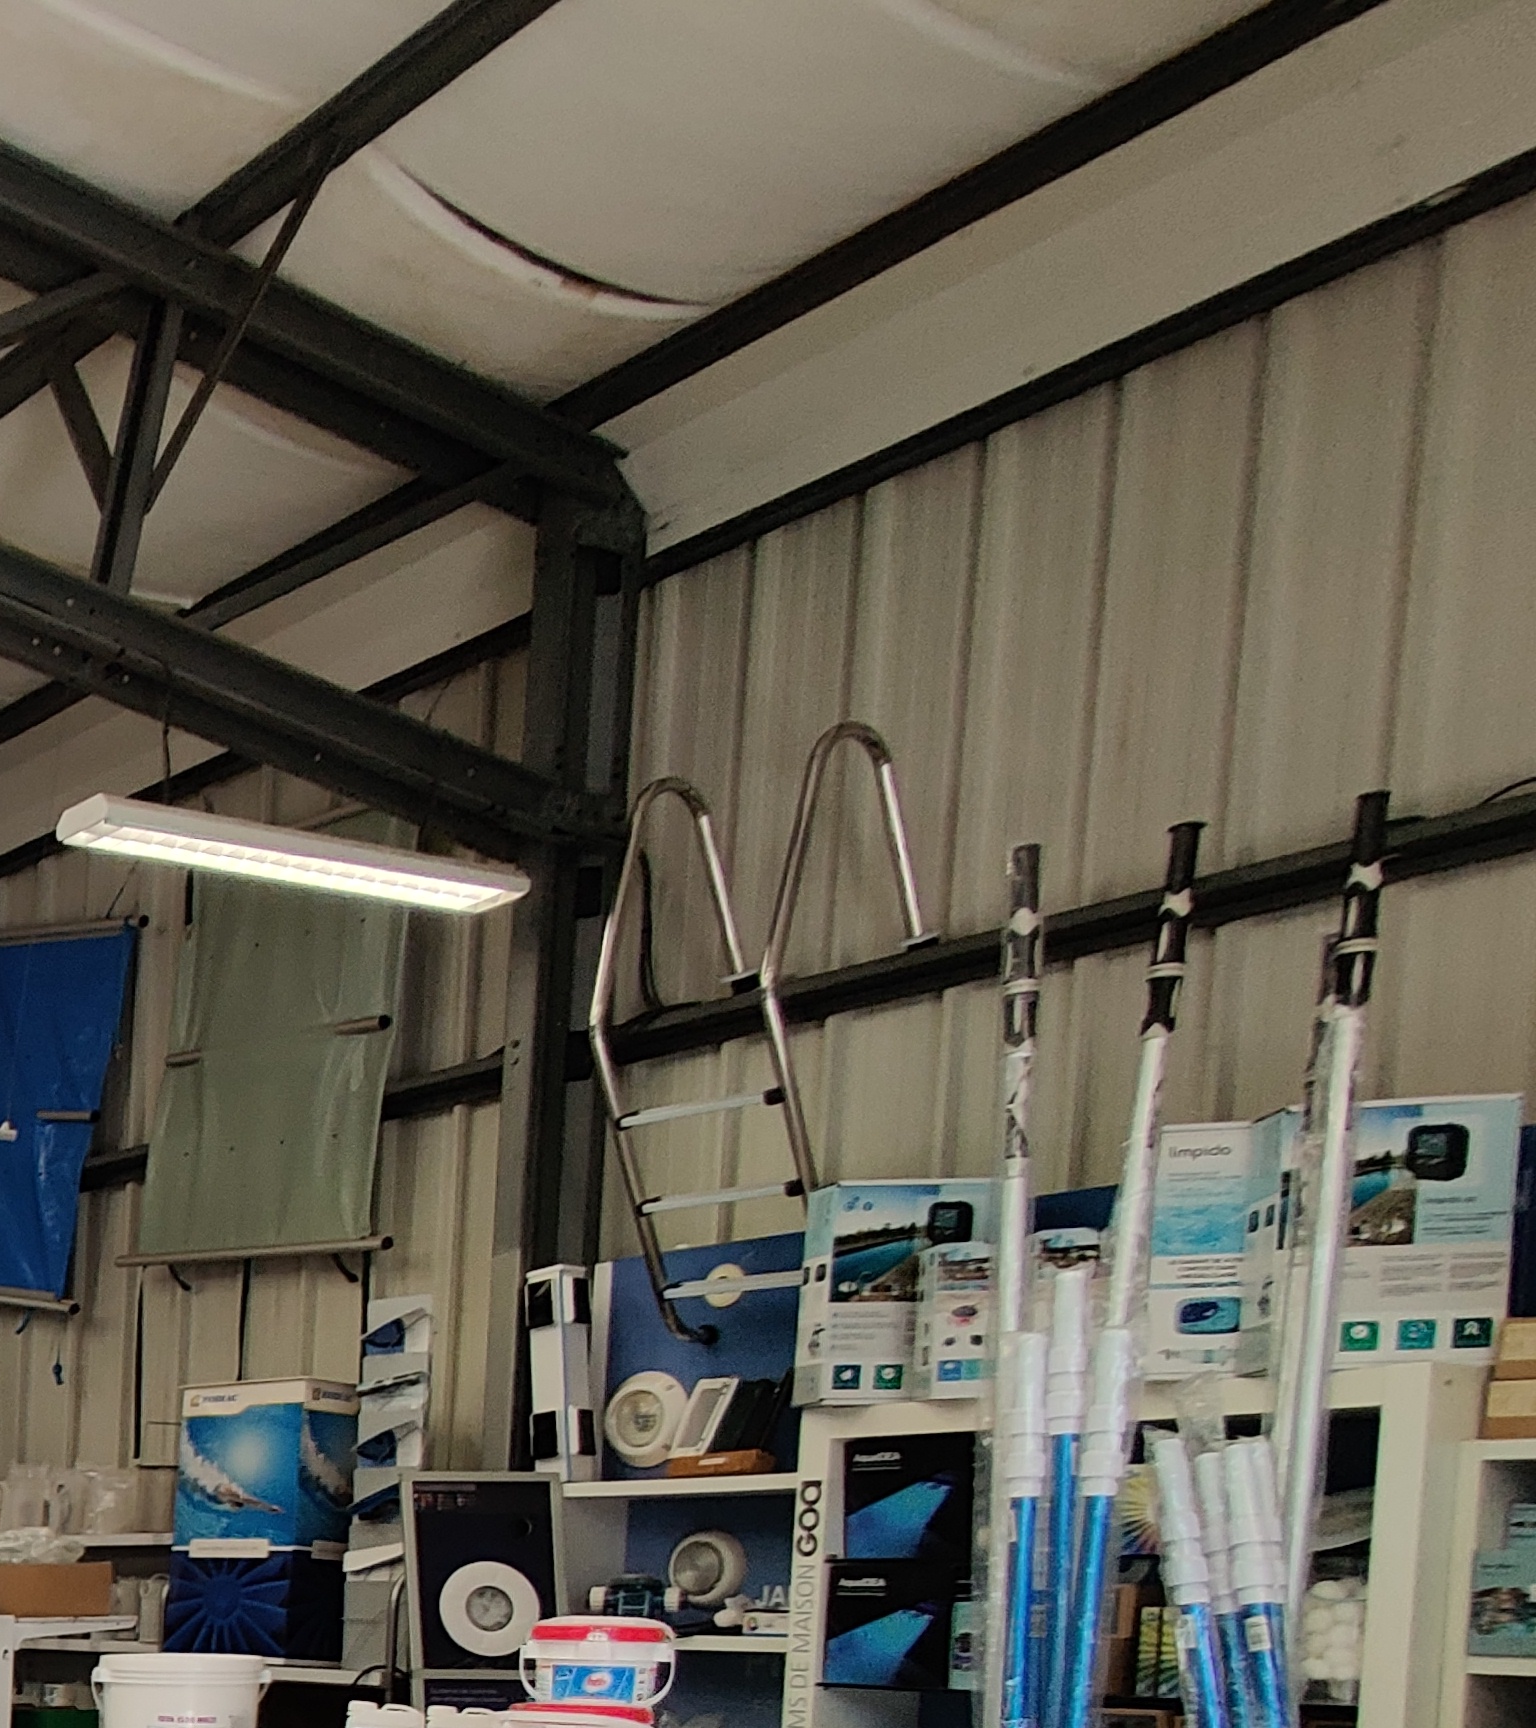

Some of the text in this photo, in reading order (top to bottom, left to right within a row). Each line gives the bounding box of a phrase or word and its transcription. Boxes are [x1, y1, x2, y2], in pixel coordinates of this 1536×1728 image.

[1168, 1144, 1232, 1161] limpido
[792, 1563, 816, 1656] MAISON
[790, 1663, 809, 1689] DE
